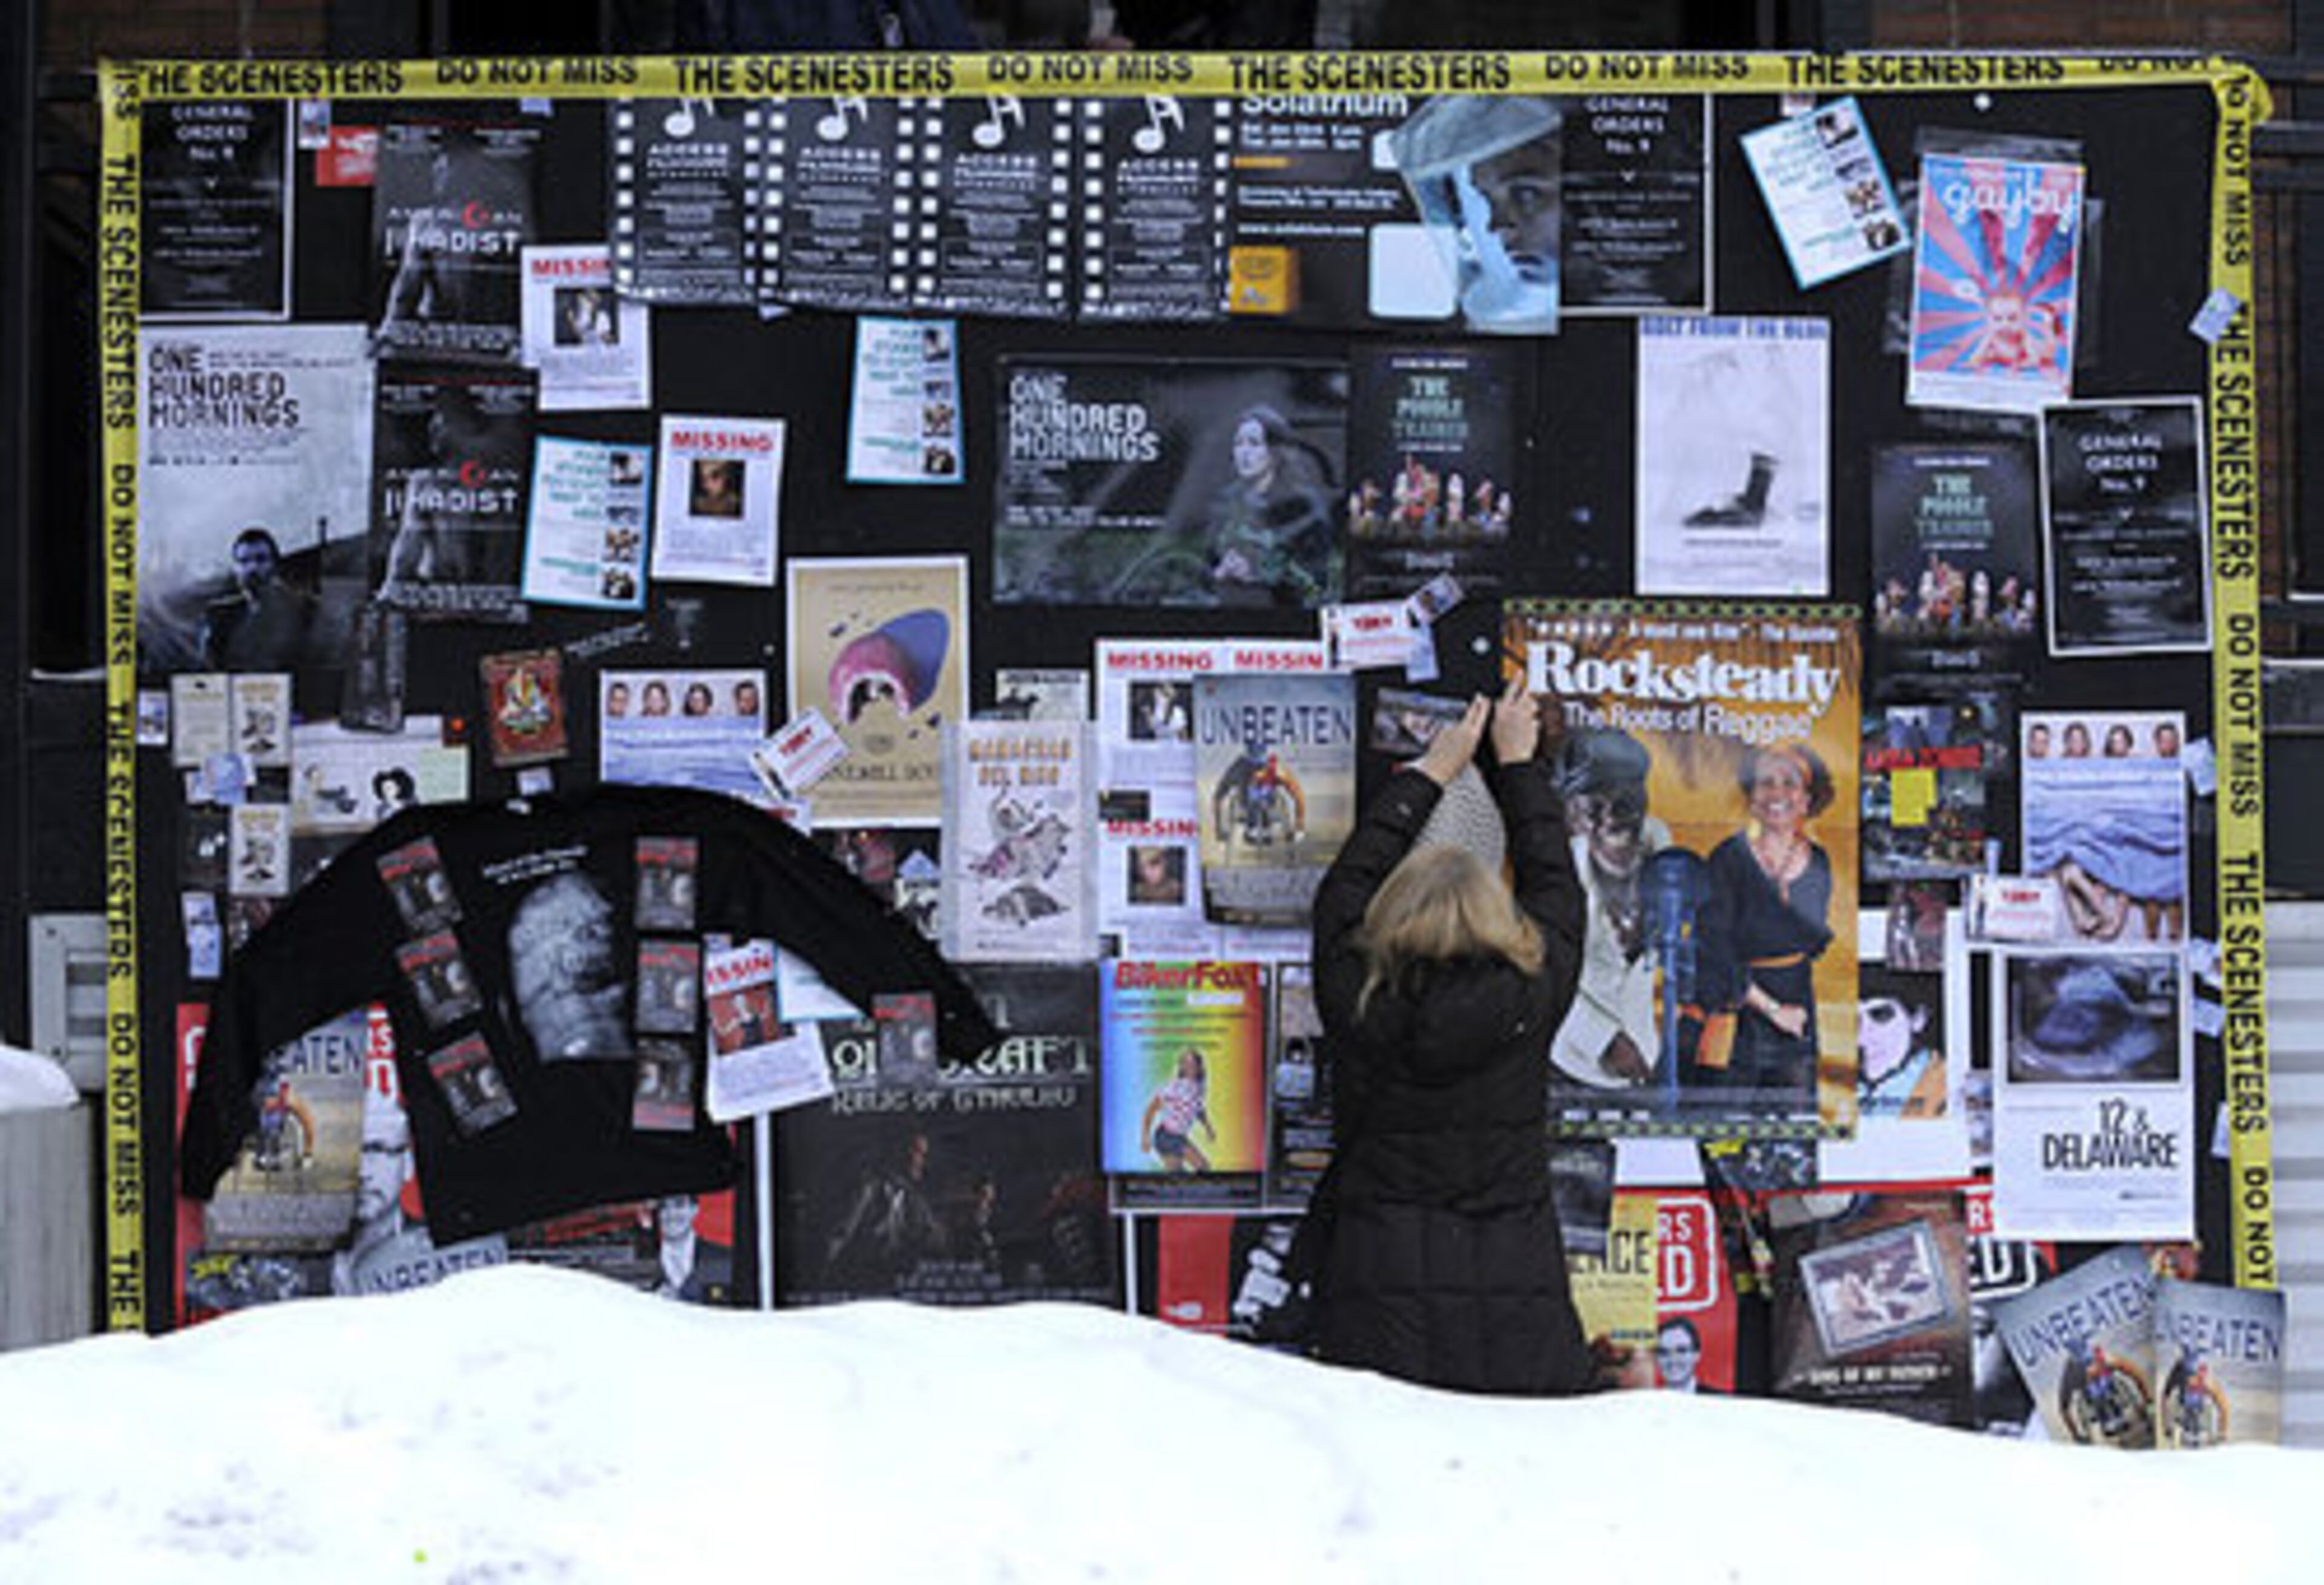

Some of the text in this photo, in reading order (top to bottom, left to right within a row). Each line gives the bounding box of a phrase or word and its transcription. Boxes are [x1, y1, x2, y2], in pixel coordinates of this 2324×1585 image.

[200, 61, 404, 93] SCENESTERS
[437, 56, 637, 85] DO NOT MISS
[674, 58, 955, 91] THE SCENESTERS
[988, 56, 1193, 82] DO NOT MISS
[1230, 55, 1512, 90] THE SCENESTERS
[1545, 54, 1749, 81] DO NOT MISS
[1784, 56, 2065, 85] THE SCENESTERS
[177, 125, 249, 142] ORDERS
[1592, 116, 1665, 133] ORDERS
[2224, 119, 2248, 177] NOT
[1943, 166, 2076, 236] gayby
[2225, 195, 2250, 267] MISS
[105, 155, 136, 428] THE SCENESTERS
[148, 345, 203, 373] ONE
[148, 373, 286, 402] HUNDRED
[1009, 375, 1068, 404] ONE
[148, 399, 300, 428] MORNINGS
[1009, 404, 1147, 434] HUNDRED
[671, 430, 775, 451] MISSING
[1009, 431, 1160, 462] MORNINGS
[2079, 434, 2162, 451] GENERAL
[2086, 454, 2159, 471] ORDERS
[2216, 372, 2254, 581] SCENESTERS
[112, 464, 135, 507] DO
[111, 517, 135, 580] NOT
[1106, 650, 1214, 671] MISSING
[1524, 641, 1840, 717] Rocksteady
[1200, 703, 1352, 746] UNBEATEN
[1562, 701, 1812, 744] The Roots of Reggae
[2227, 613, 2259, 818] DO NOT MISS
[2222, 852, 2267, 1135] THE SCENESTERS
[111, 1012, 140, 1215] DO NOT MISS
[2043, 1134, 2179, 1172] DELAWARE
[2244, 1166, 2274, 1282] DO NOT
[110, 1250, 140, 1313] THE
[2012, 1275, 2156, 1366] UNBEATEN
